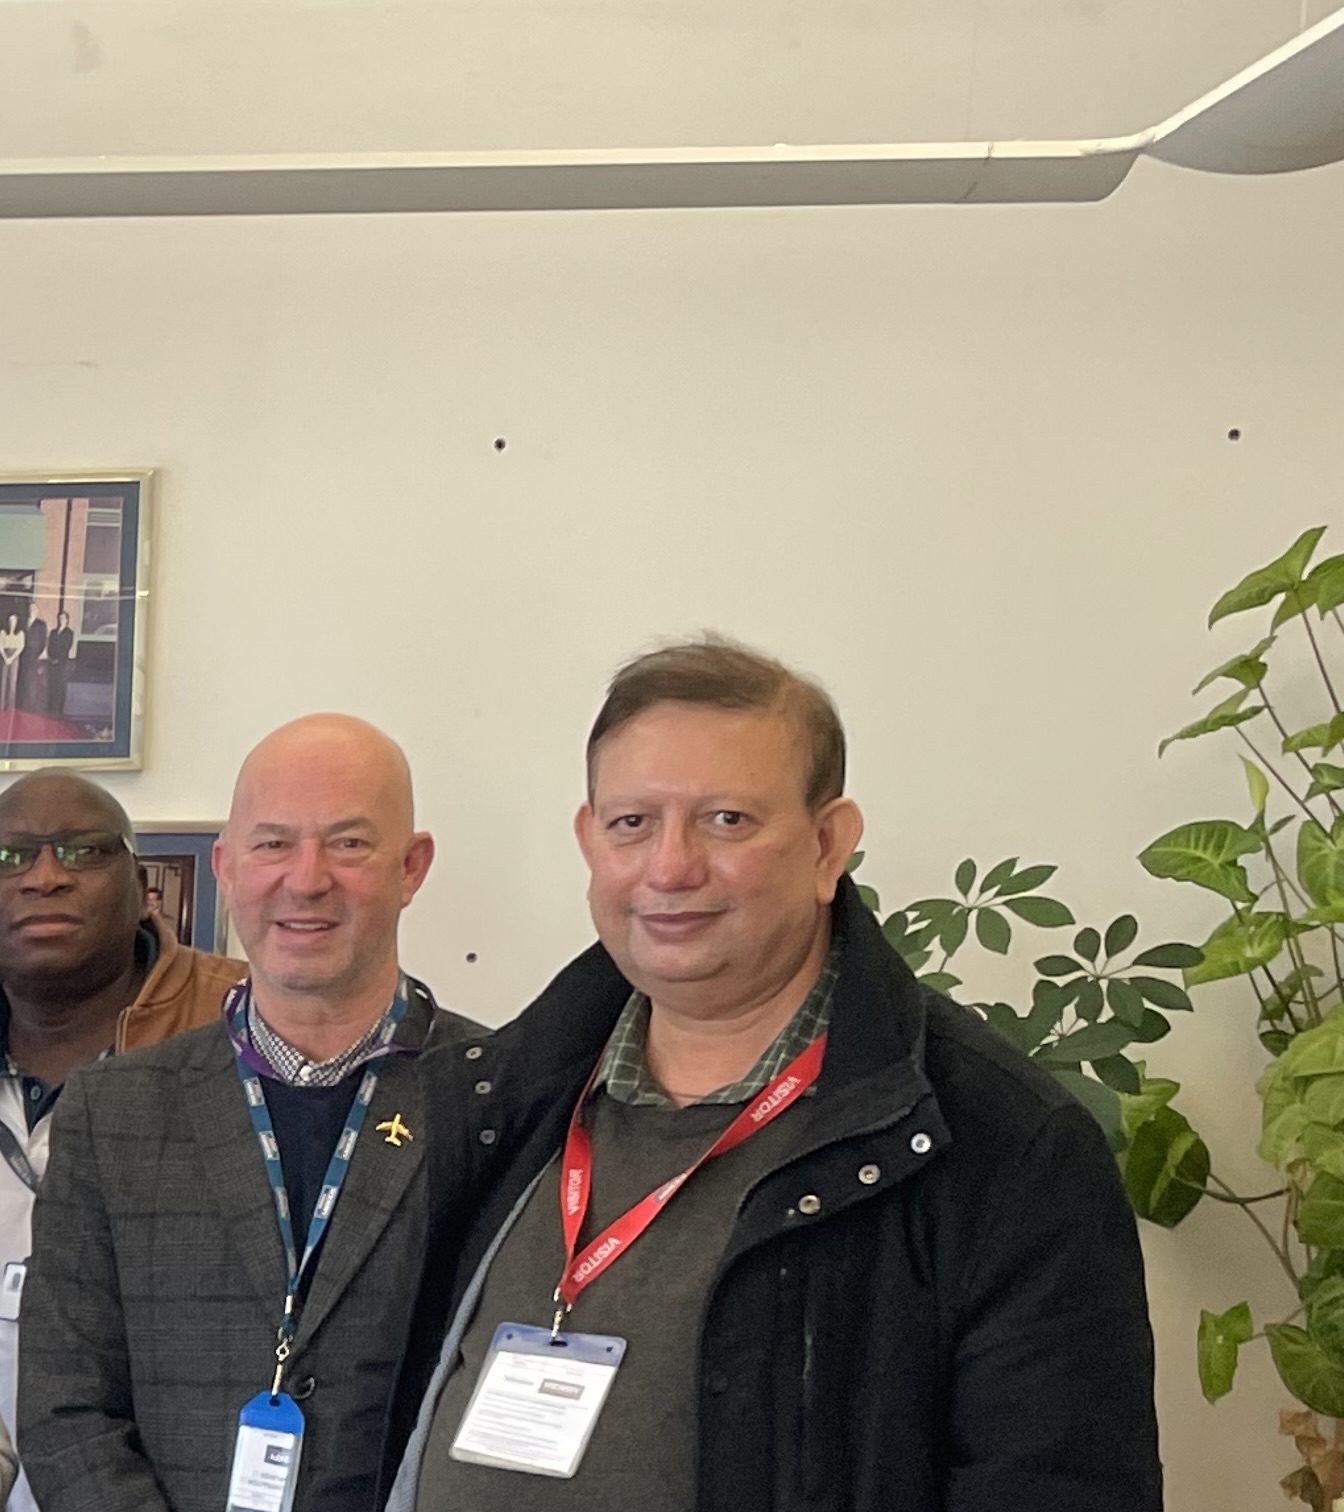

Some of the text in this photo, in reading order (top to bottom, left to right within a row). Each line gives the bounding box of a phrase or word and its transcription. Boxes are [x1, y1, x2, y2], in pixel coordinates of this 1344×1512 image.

[750, 1075, 803, 1122] VISITOR
[568, 1168, 584, 1216] VISITOR
[572, 1236, 621, 1283] VISITOR
